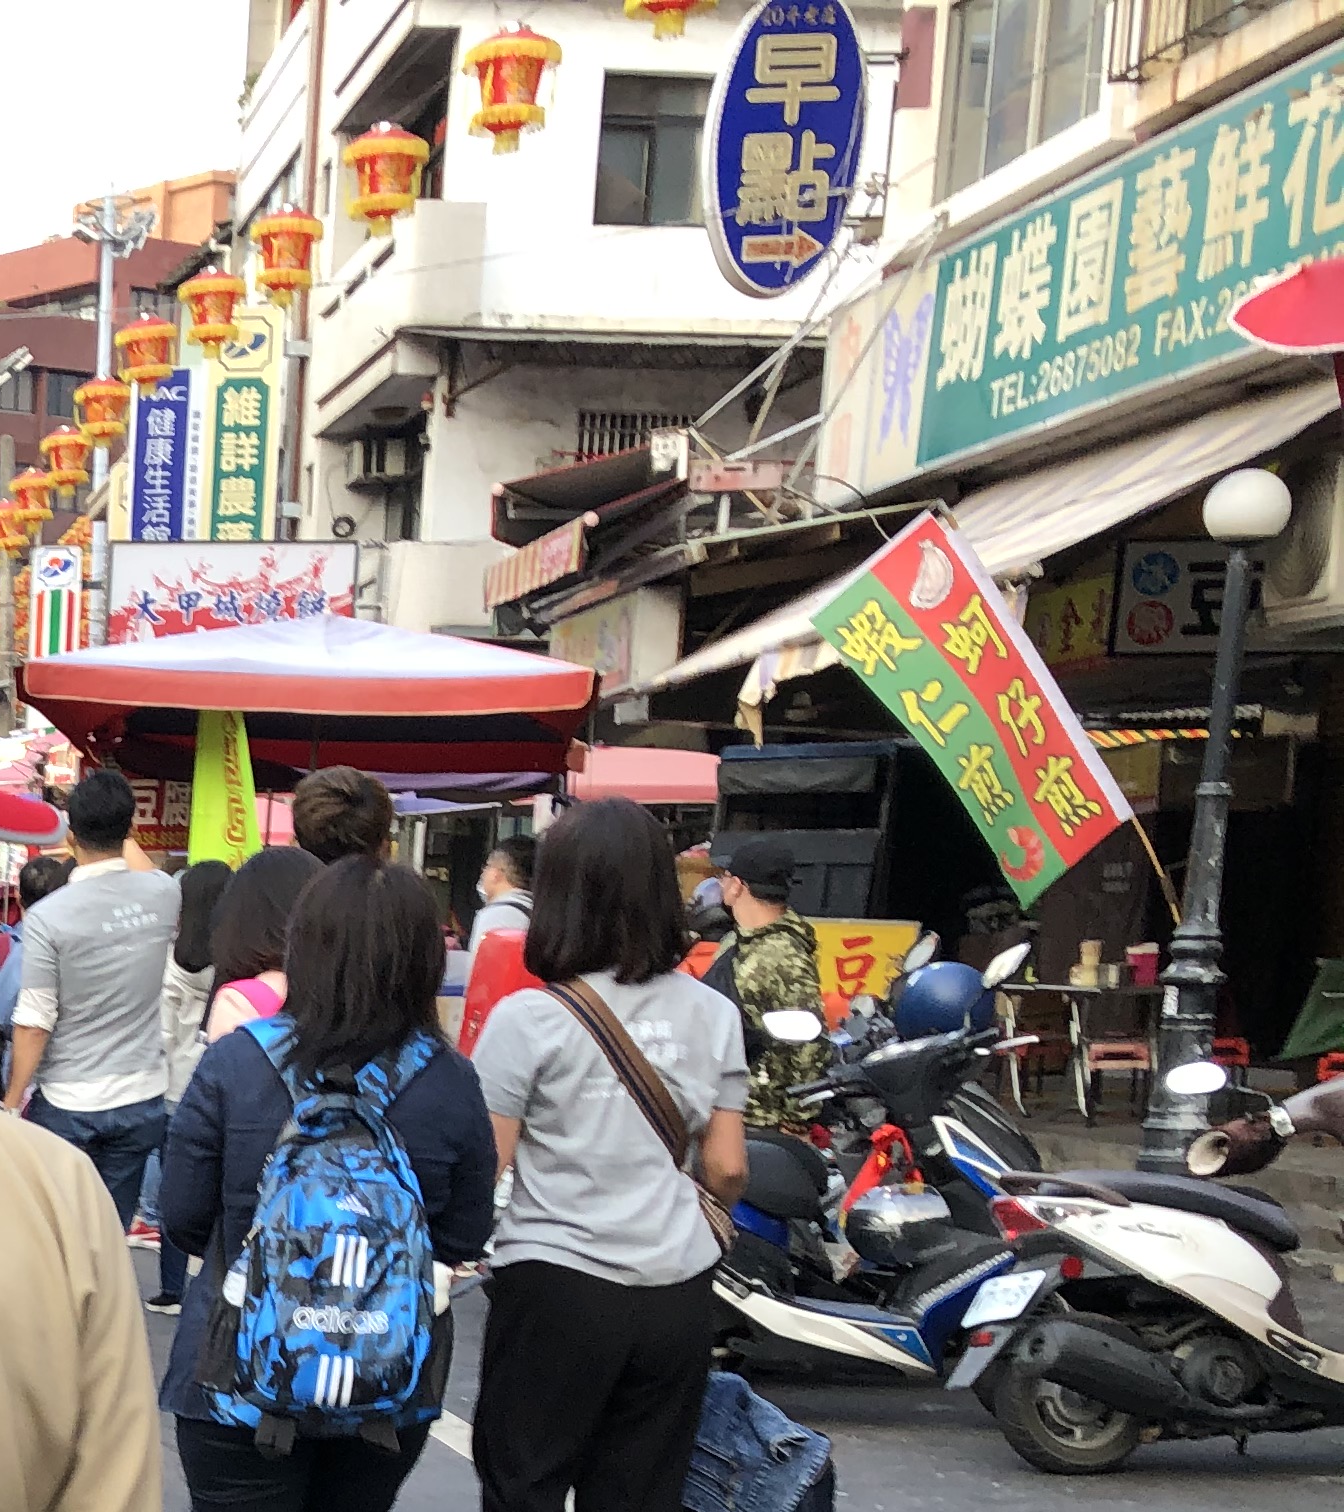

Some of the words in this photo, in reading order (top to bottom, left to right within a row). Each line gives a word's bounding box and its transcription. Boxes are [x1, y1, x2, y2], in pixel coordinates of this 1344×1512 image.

[736, 33, 840, 226] 早點
[990, 325, 1142, 420] TEL:26875082
[835, 600, 1014, 827] 蝦仁煎
[942, 594, 1103, 836] 蚵仔煎
[292, 1305, 390, 1335] adidas
